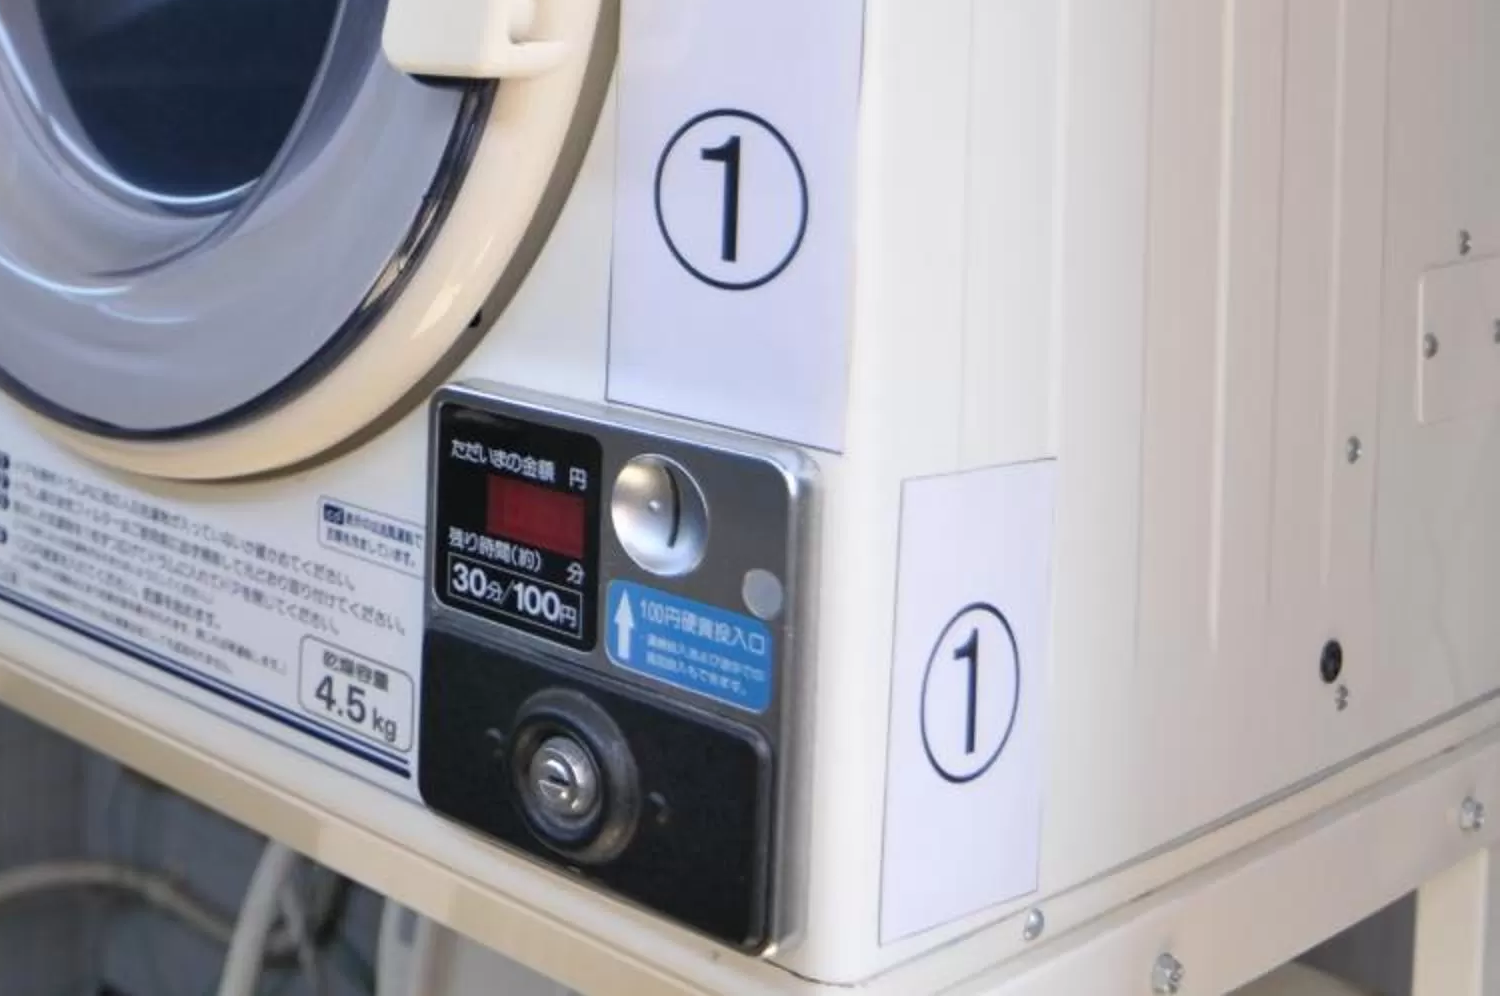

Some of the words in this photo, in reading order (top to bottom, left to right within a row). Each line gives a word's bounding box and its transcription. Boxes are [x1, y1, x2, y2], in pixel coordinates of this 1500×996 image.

[568, 465, 589, 492] 円
[565, 562, 585, 585] 分
[314, 675, 367, 724] 4.5
